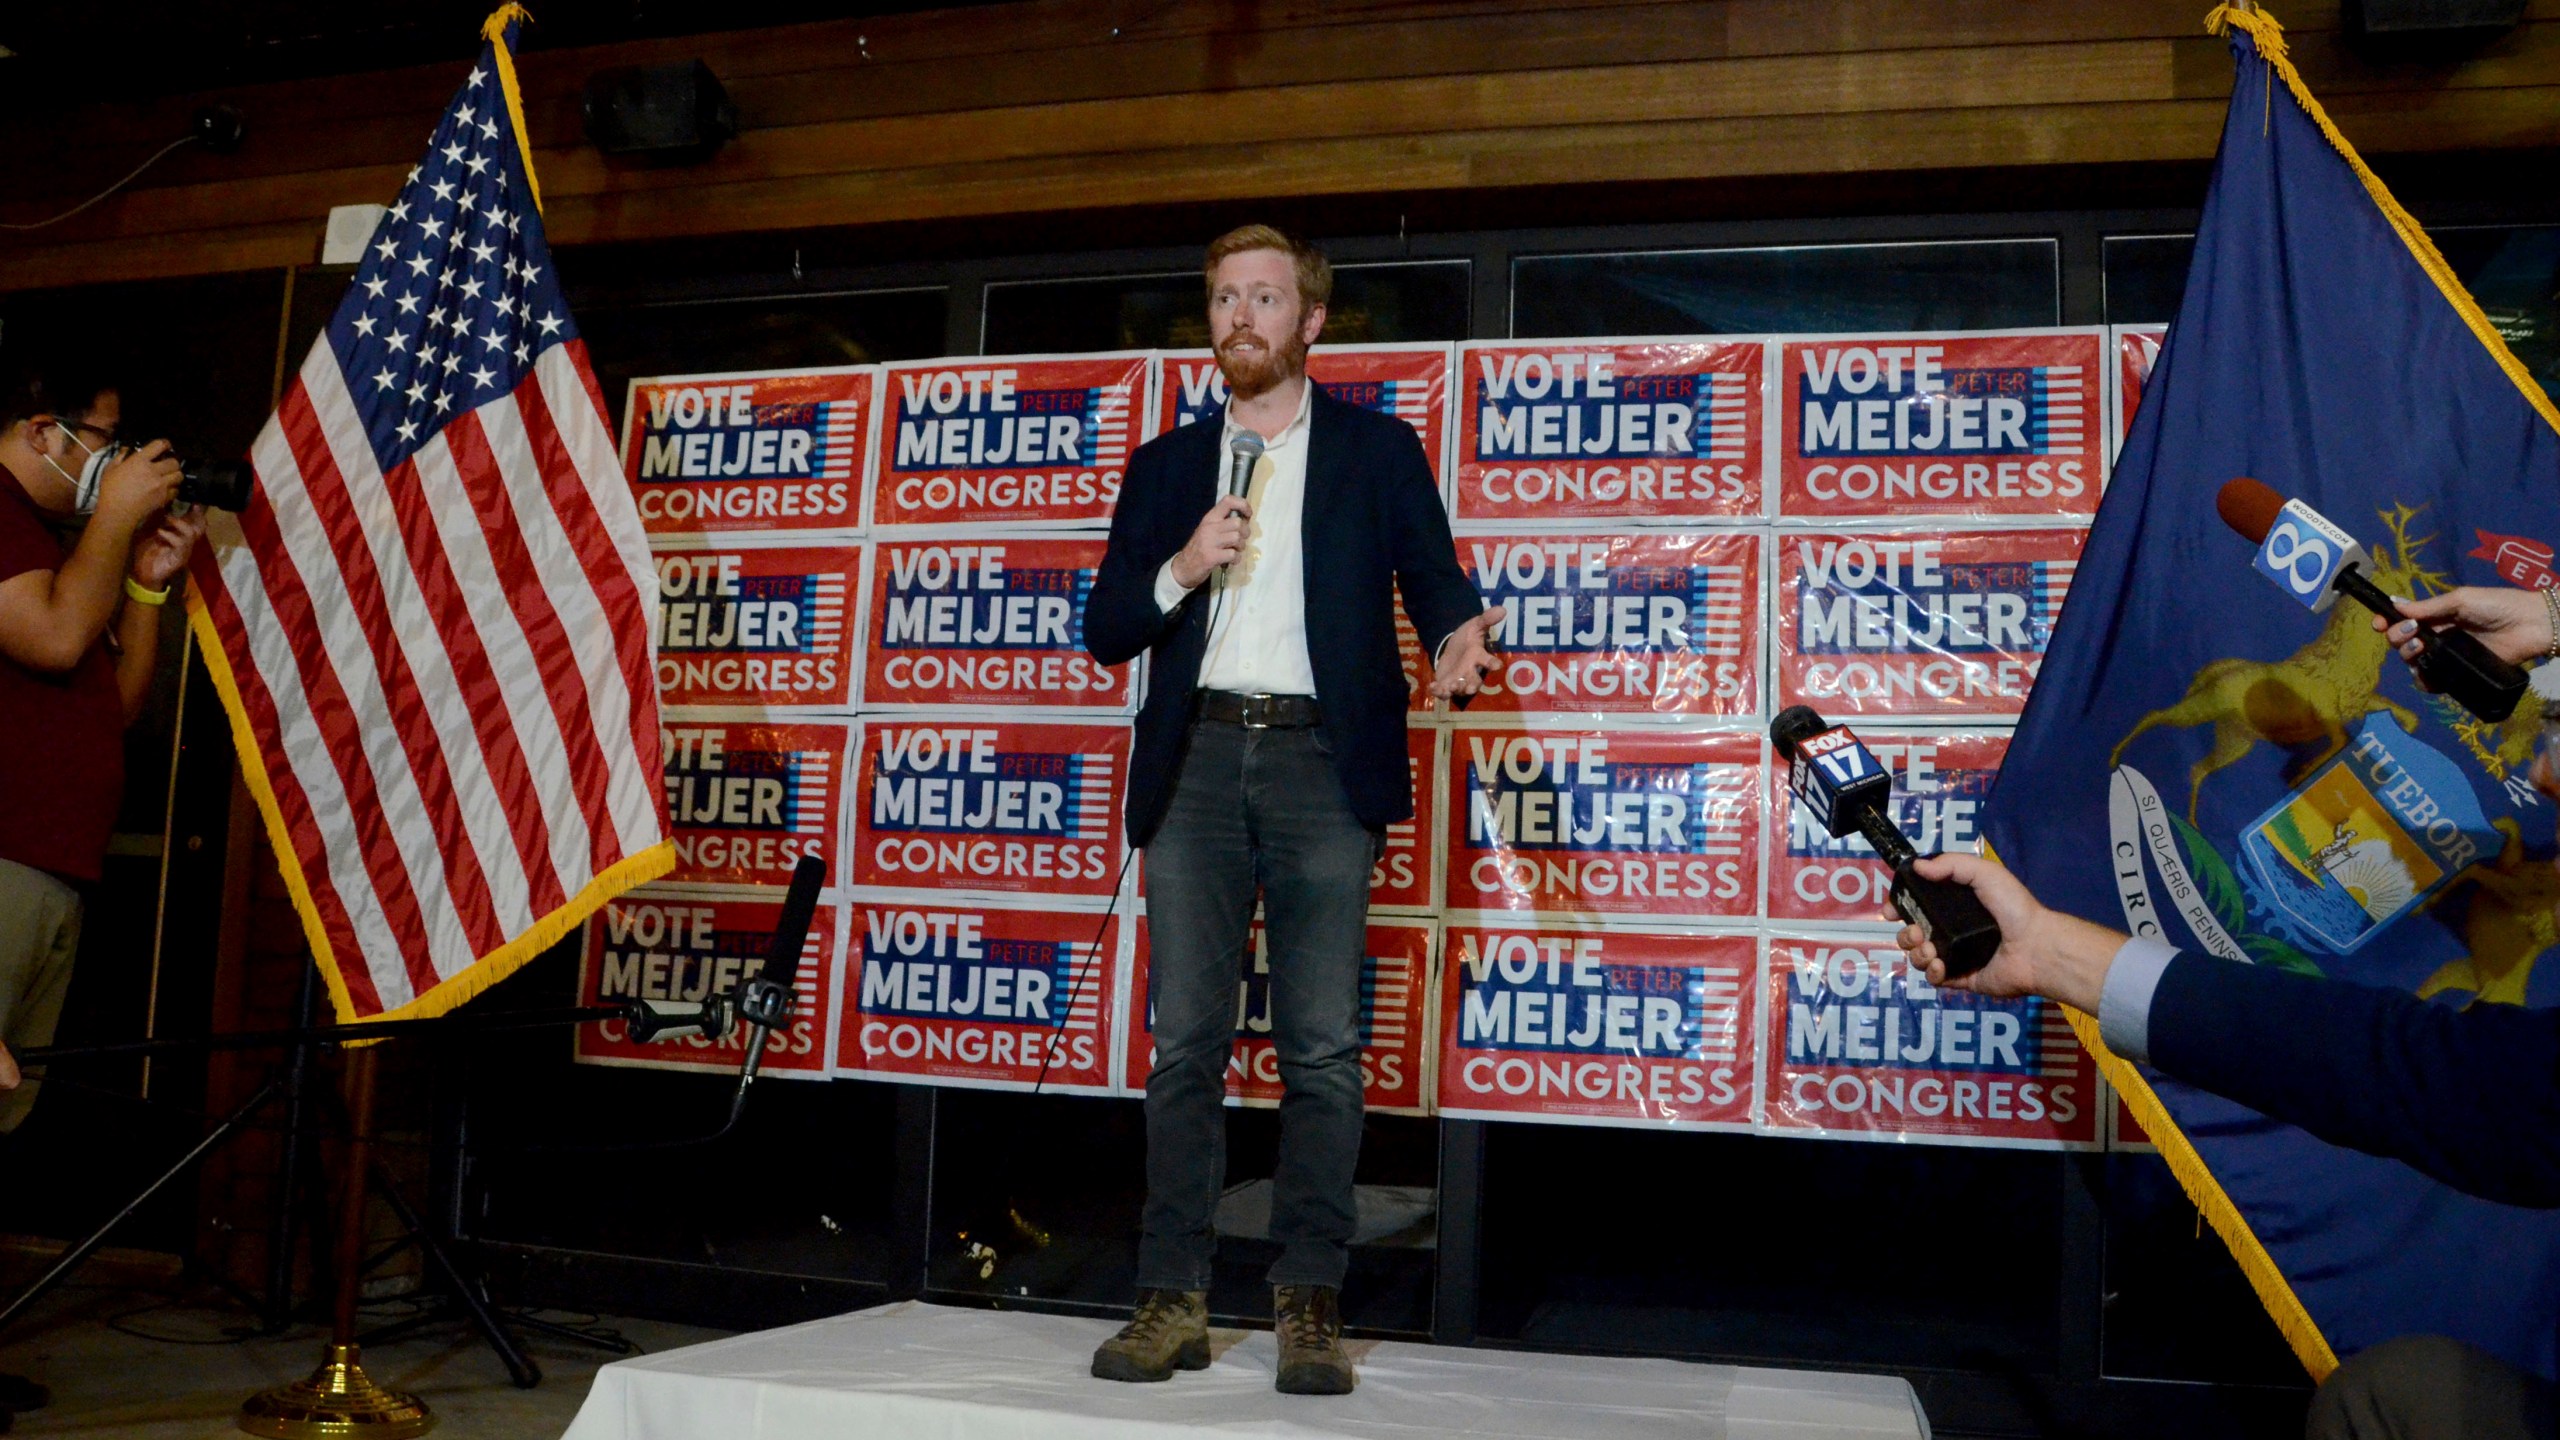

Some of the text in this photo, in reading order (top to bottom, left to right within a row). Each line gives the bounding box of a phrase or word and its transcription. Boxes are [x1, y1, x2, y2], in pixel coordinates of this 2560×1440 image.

[902, 369, 1018, 415] VOTE
[1480, 353, 1615, 399] VOTE
[1623, 379, 1692, 399] PETER
[1801, 346, 1944, 394] VOTE
[1954, 372, 2026, 393] PETER
[648, 385, 754, 430] VOTE
[757, 406, 814, 427] PETER
[1023, 392, 1084, 412] PETER
[1804, 398, 2028, 451] MEIJER
[897, 415, 1081, 466] MEIJER
[1481, 403, 1693, 454] MEIJER
[641, 428, 812, 478] MEIJER
[639, 482, 848, 519] CONGRESS
[895, 471, 1122, 510] CONGRESS
[1482, 465, 1744, 503] CONGRESS
[1806, 461, 2085, 500] CONGRESS
[2292, 502, 2350, 545] WOODTV.COM
[655, 555, 742, 597] OTE
[891, 546, 1005, 591] VOTE
[1011, 573, 1073, 591] PETER
[1472, 543, 1609, 589] VOTE
[1617, 572, 1687, 591] PETER
[1799, 540, 1943, 589] VOTE
[1953, 568, 2026, 589] PETER
[2511, 561, 2529, 580] E
[745, 579, 801, 598] PETER
[886, 596, 1071, 644] MEIJER
[1803, 594, 2029, 648] MEIJER
[658, 658, 837, 692] ONGRESS
[884, 655, 1115, 692] CONGRESS
[1805, 661, 2040, 699] CONGRE
[880, 728, 998, 773] VOTE
[1469, 737, 1608, 784] VOTE
[1802, 729, 1853, 757] FOX
[1816, 745, 1865, 783] 17
[1003, 757, 1065, 777] PETER
[1793, 751, 1807, 797] FOX
[665, 776, 784, 825] EIJER
[874, 777, 1063, 830] MEIJER
[1805, 766, 1830, 822] 17
[2141, 795, 2157, 812] SI
[2352, 731, 2477, 871] TUEBOR
[1469, 790, 1687, 846] MEIJER
[875, 838, 1106, 880] CONGRESS
[1470, 856, 1741, 899] CONGRESS
[606, 904, 715, 950] VOTE
[866, 909, 983, 959] VOTE
[989, 943, 1053, 963] PETER
[1462, 934, 1603, 987] VOTE
[861, 960, 1050, 1019] MEIJER
[1610, 969, 1683, 991] PETER
[1463, 989, 1683, 1050] MEIJER
[1790, 1003, 2021, 1066] MEIJER
[859, 1021, 1094, 1070] CONGRESS
[1463, 1056, 1735, 1105] CONGRESS
[1791, 1073, 2078, 1122] CONGRESS
